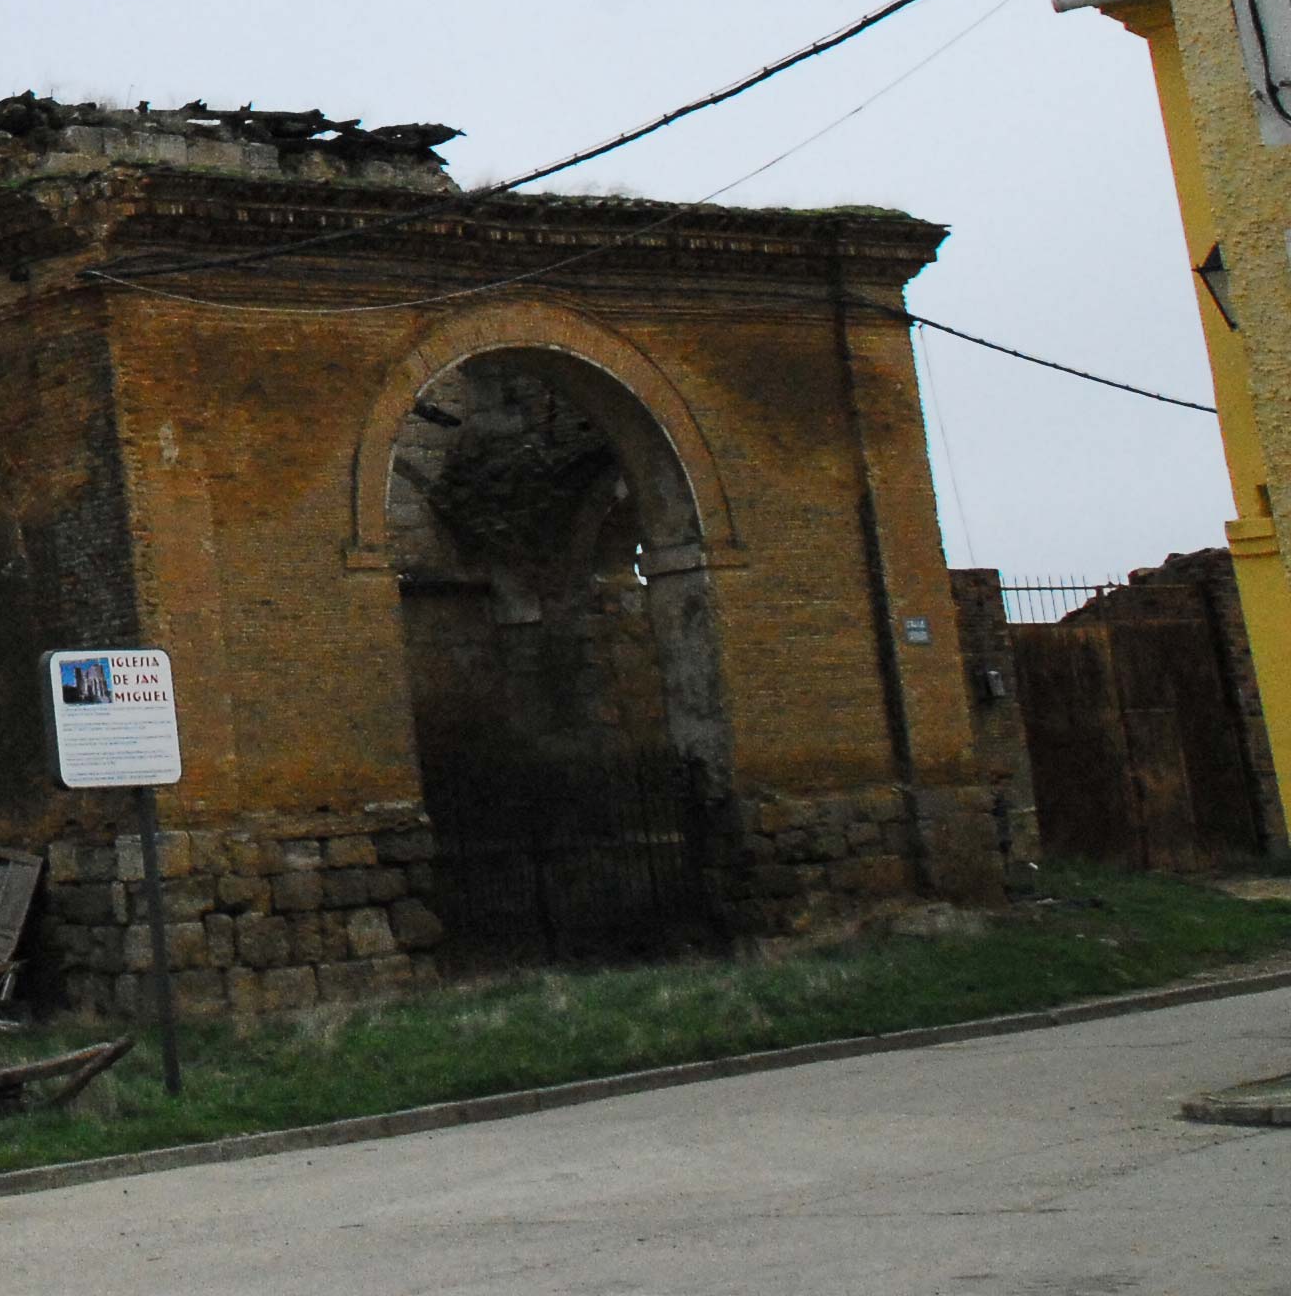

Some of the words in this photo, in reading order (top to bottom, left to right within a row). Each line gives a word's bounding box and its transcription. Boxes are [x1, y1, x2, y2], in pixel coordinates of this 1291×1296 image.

[111, 657, 160, 667] IGLESIA
[113, 674, 128, 685] DE
[136, 674, 159, 684] SAN
[115, 690, 168, 702] MIGUEL
